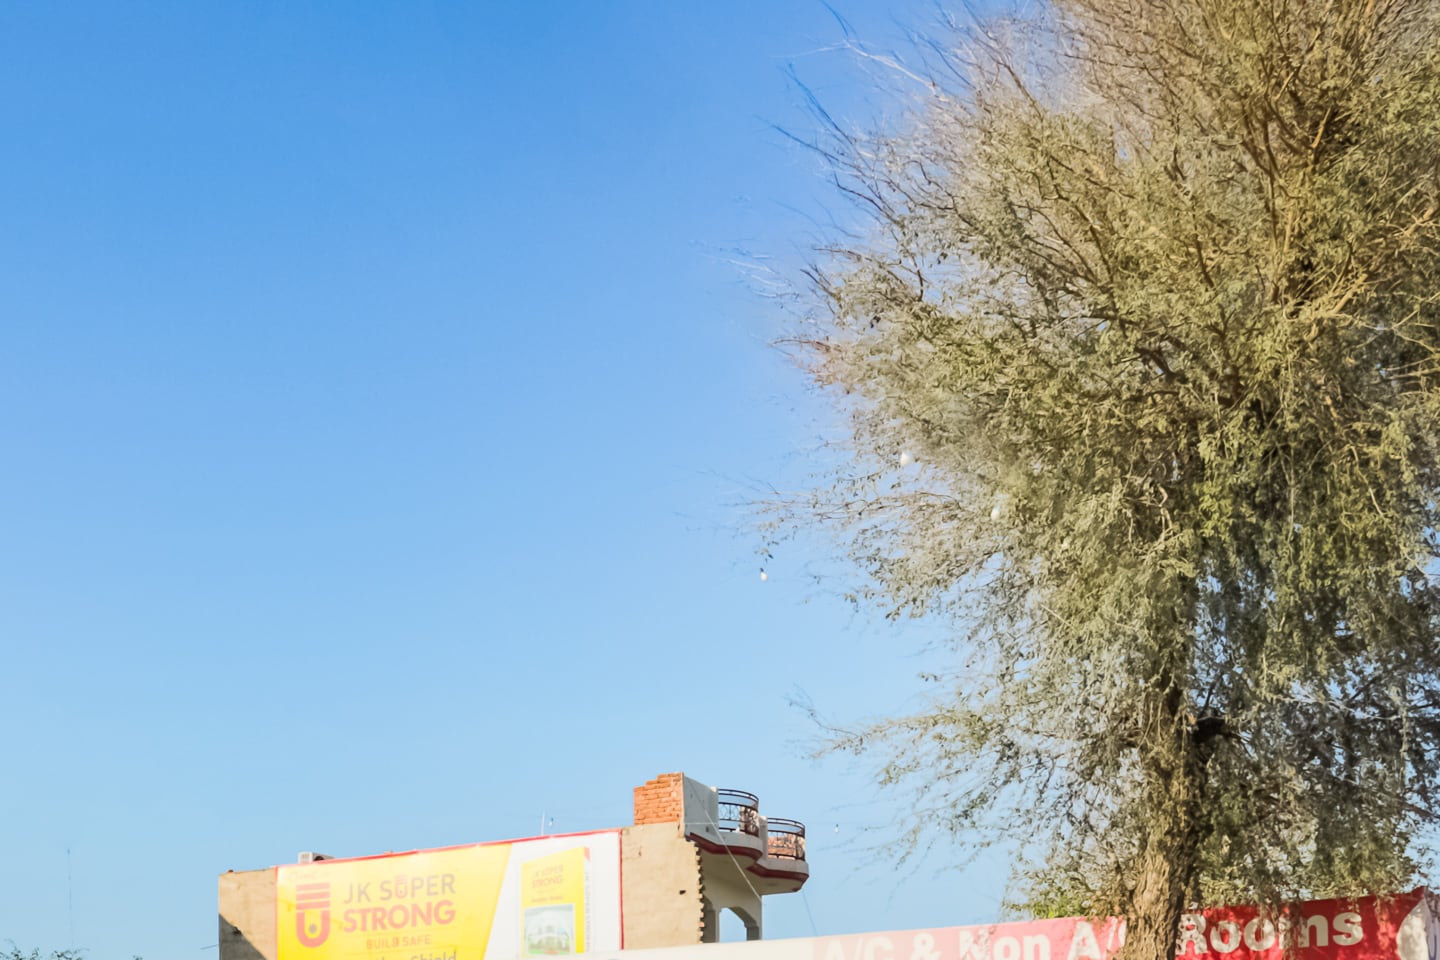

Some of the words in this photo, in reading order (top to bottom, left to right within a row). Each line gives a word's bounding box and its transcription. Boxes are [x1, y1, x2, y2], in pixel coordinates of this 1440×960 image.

[344, 882, 371, 905] JK
[379, 873, 455, 901] SUPER
[343, 900, 456, 934] STRONG
[401, 934, 431, 947] SAFE
